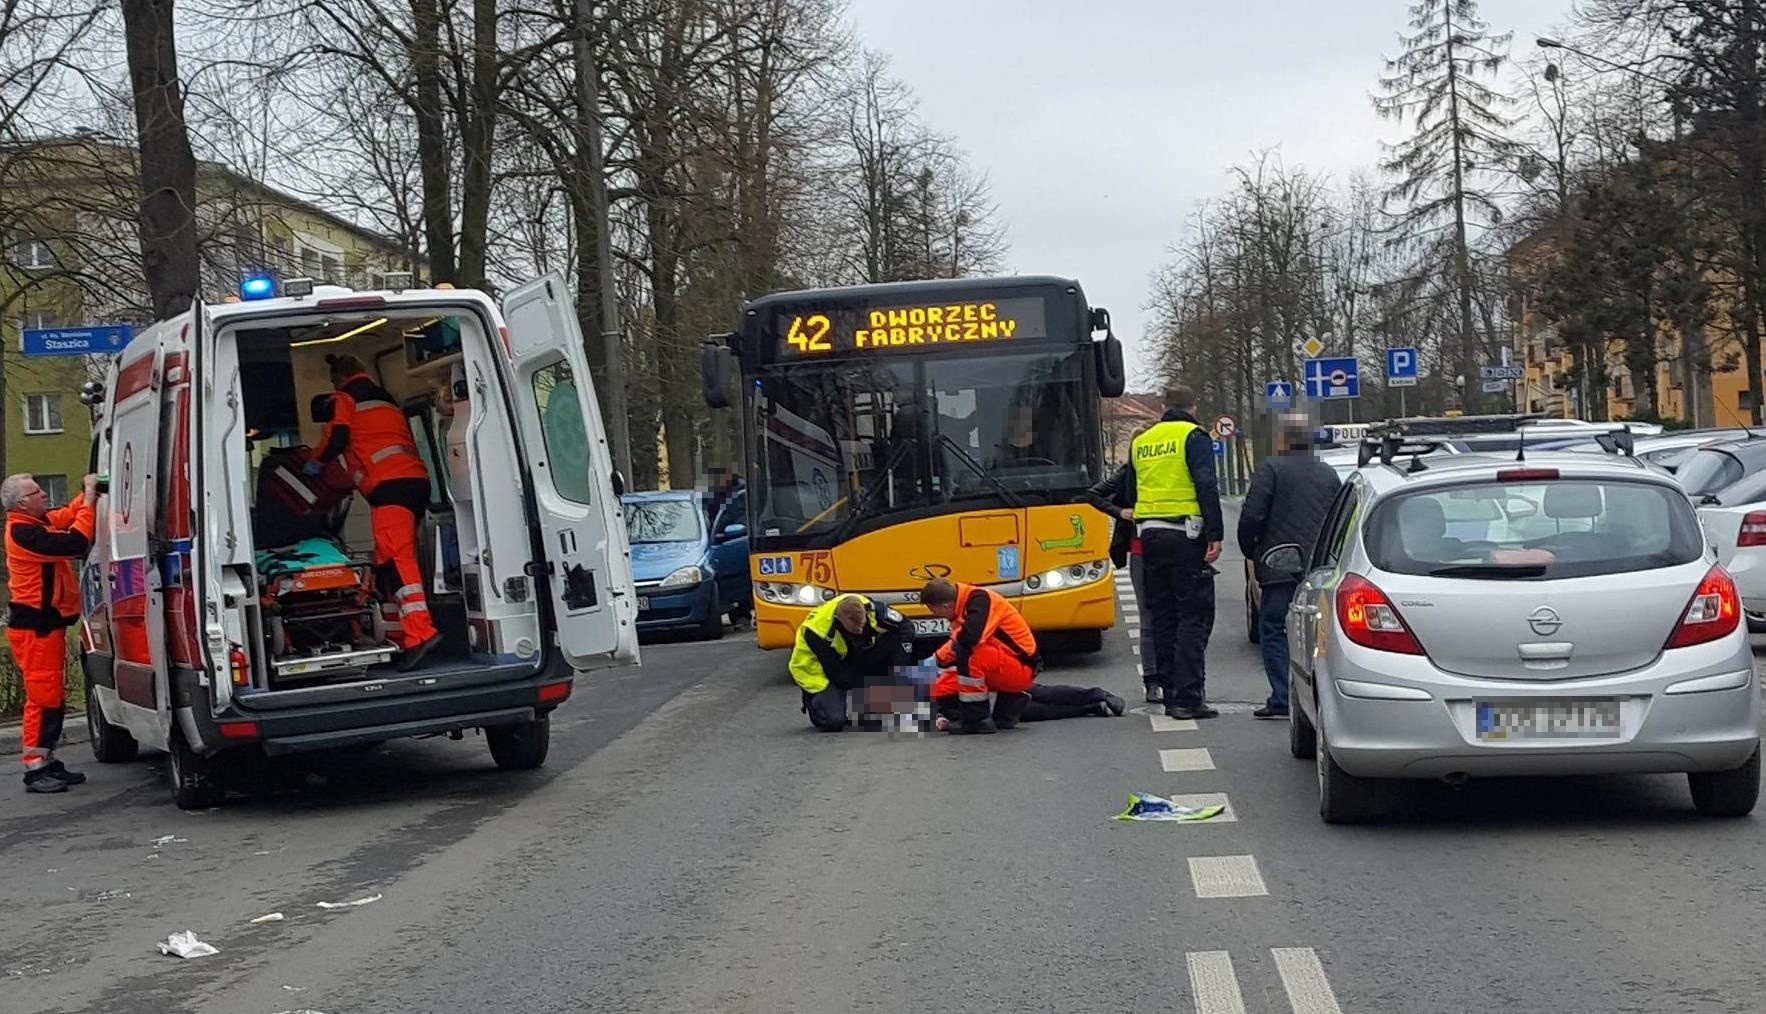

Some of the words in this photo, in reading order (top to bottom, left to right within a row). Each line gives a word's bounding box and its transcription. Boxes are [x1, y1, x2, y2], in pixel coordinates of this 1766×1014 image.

[869, 303, 996, 328] DWORZEC
[787, 314, 831, 351] 42
[855, 319, 1016, 348] FABRYCZNY
[45, 339, 90, 350] Staszica
[1393, 351, 1410, 374] P
[1333, 427, 1368, 439] POLIC
[1136, 440, 1177, 460] POLICJA
[800, 552, 831, 584] 75
[903, 592, 921, 602] SO
